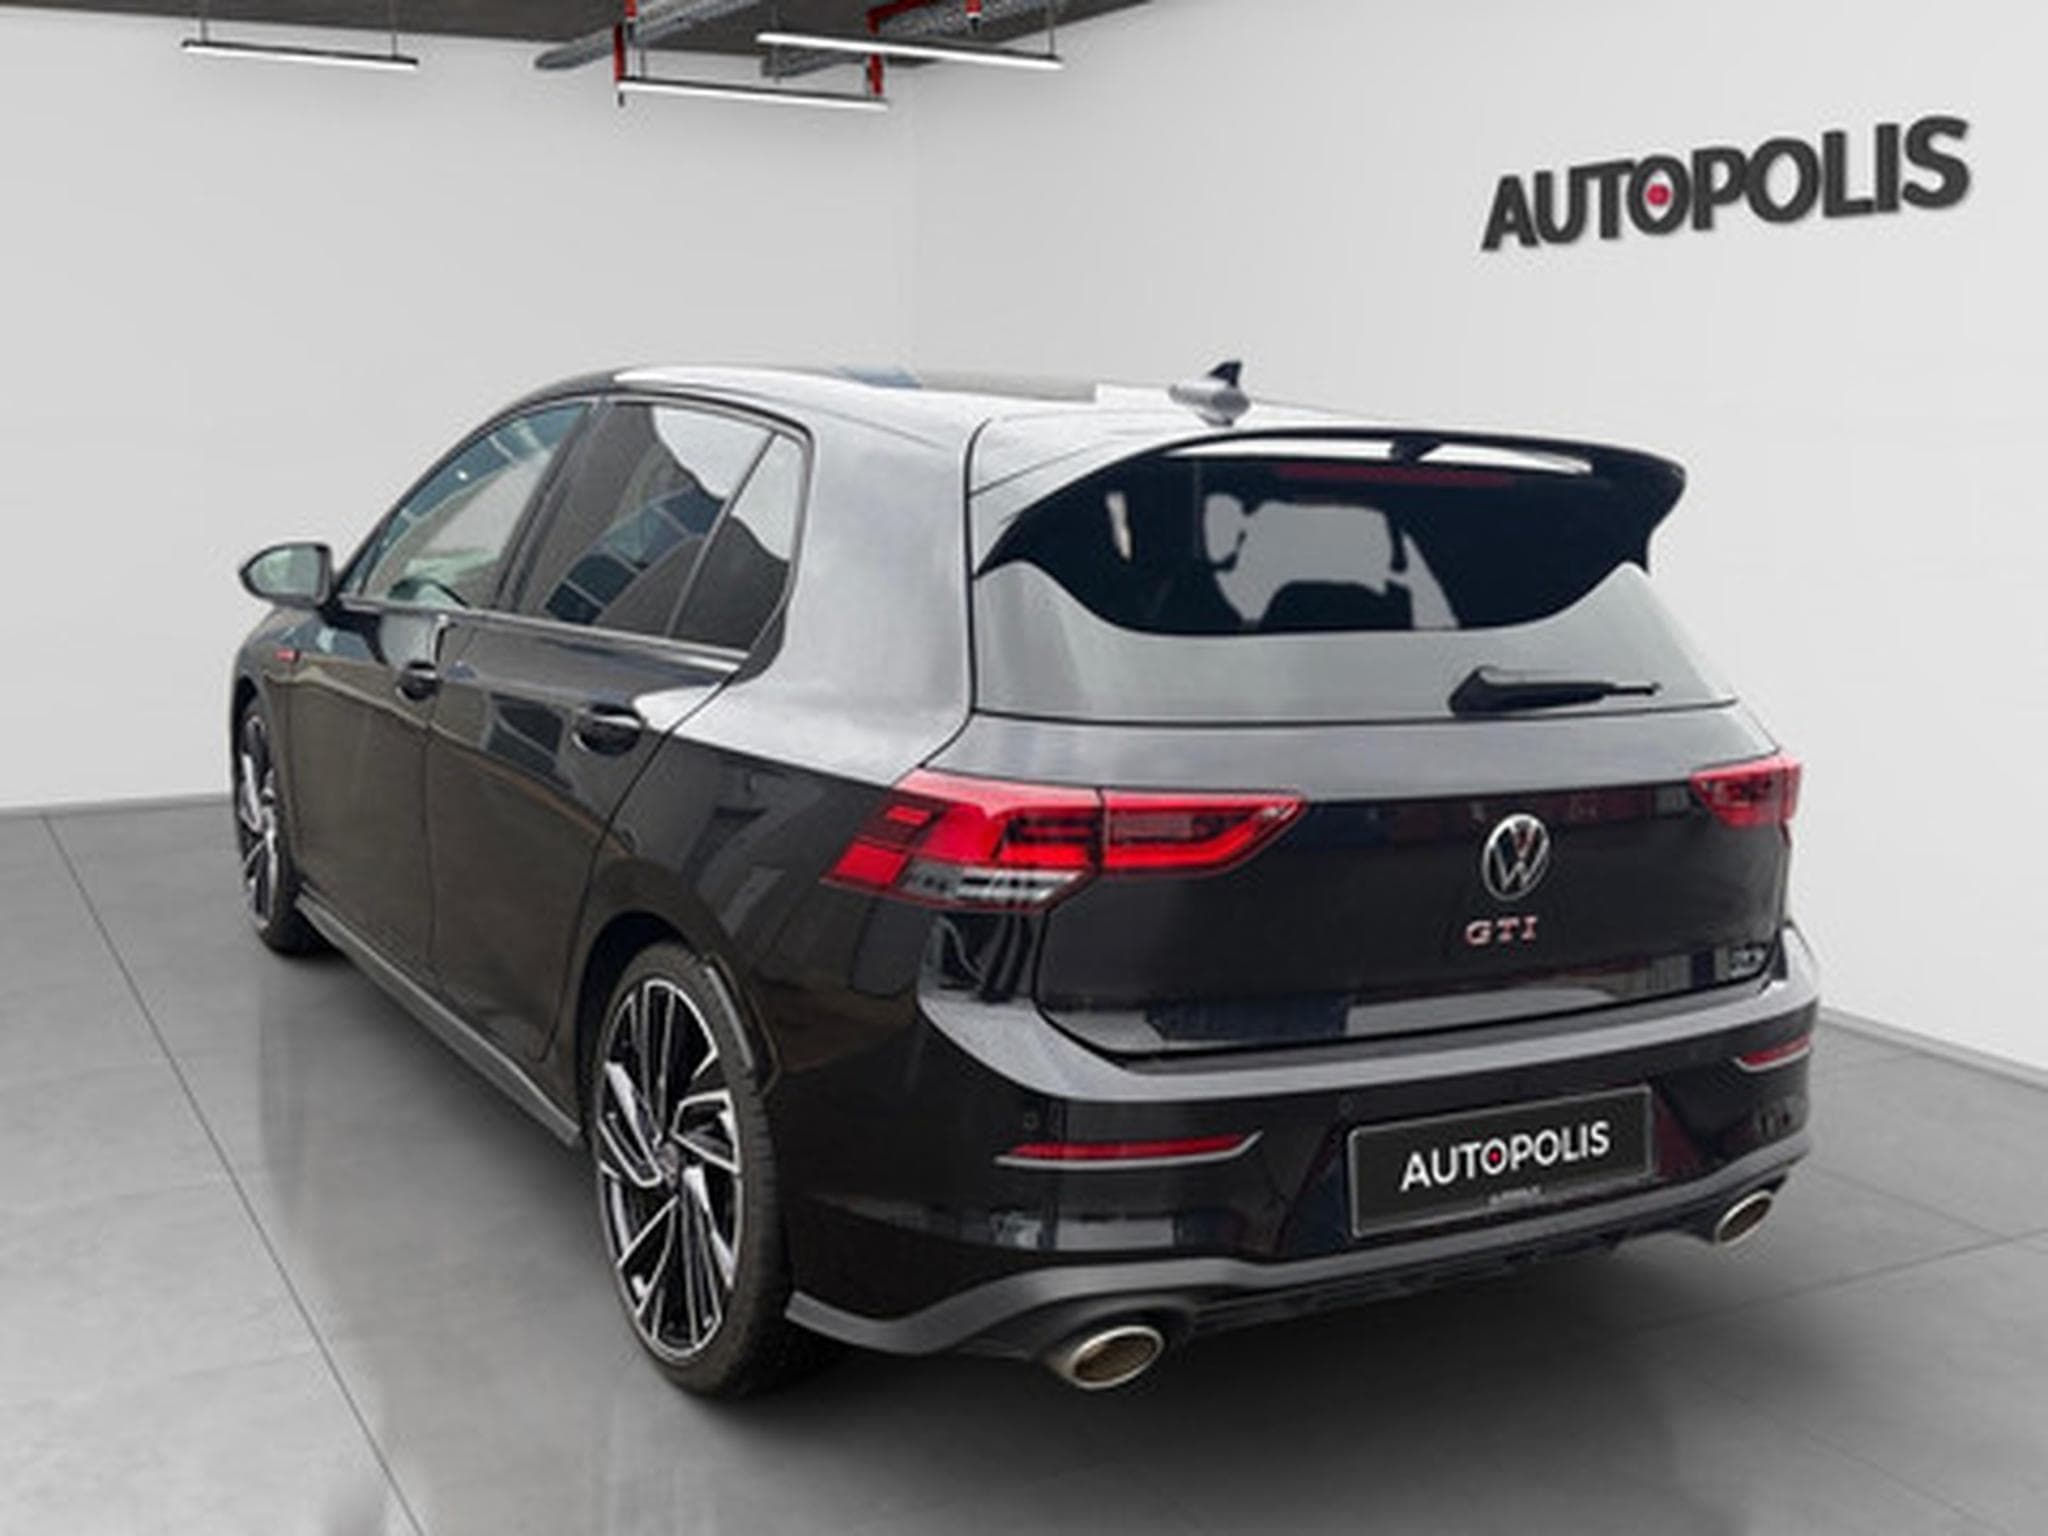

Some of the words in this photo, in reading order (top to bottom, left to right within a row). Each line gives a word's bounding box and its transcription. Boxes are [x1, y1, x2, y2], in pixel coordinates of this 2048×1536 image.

[1481, 115, 1971, 252] AUTOPOLIS
[1465, 916, 1538, 945] GTI
[1401, 1120, 1610, 1191] AUTOPOLIS
